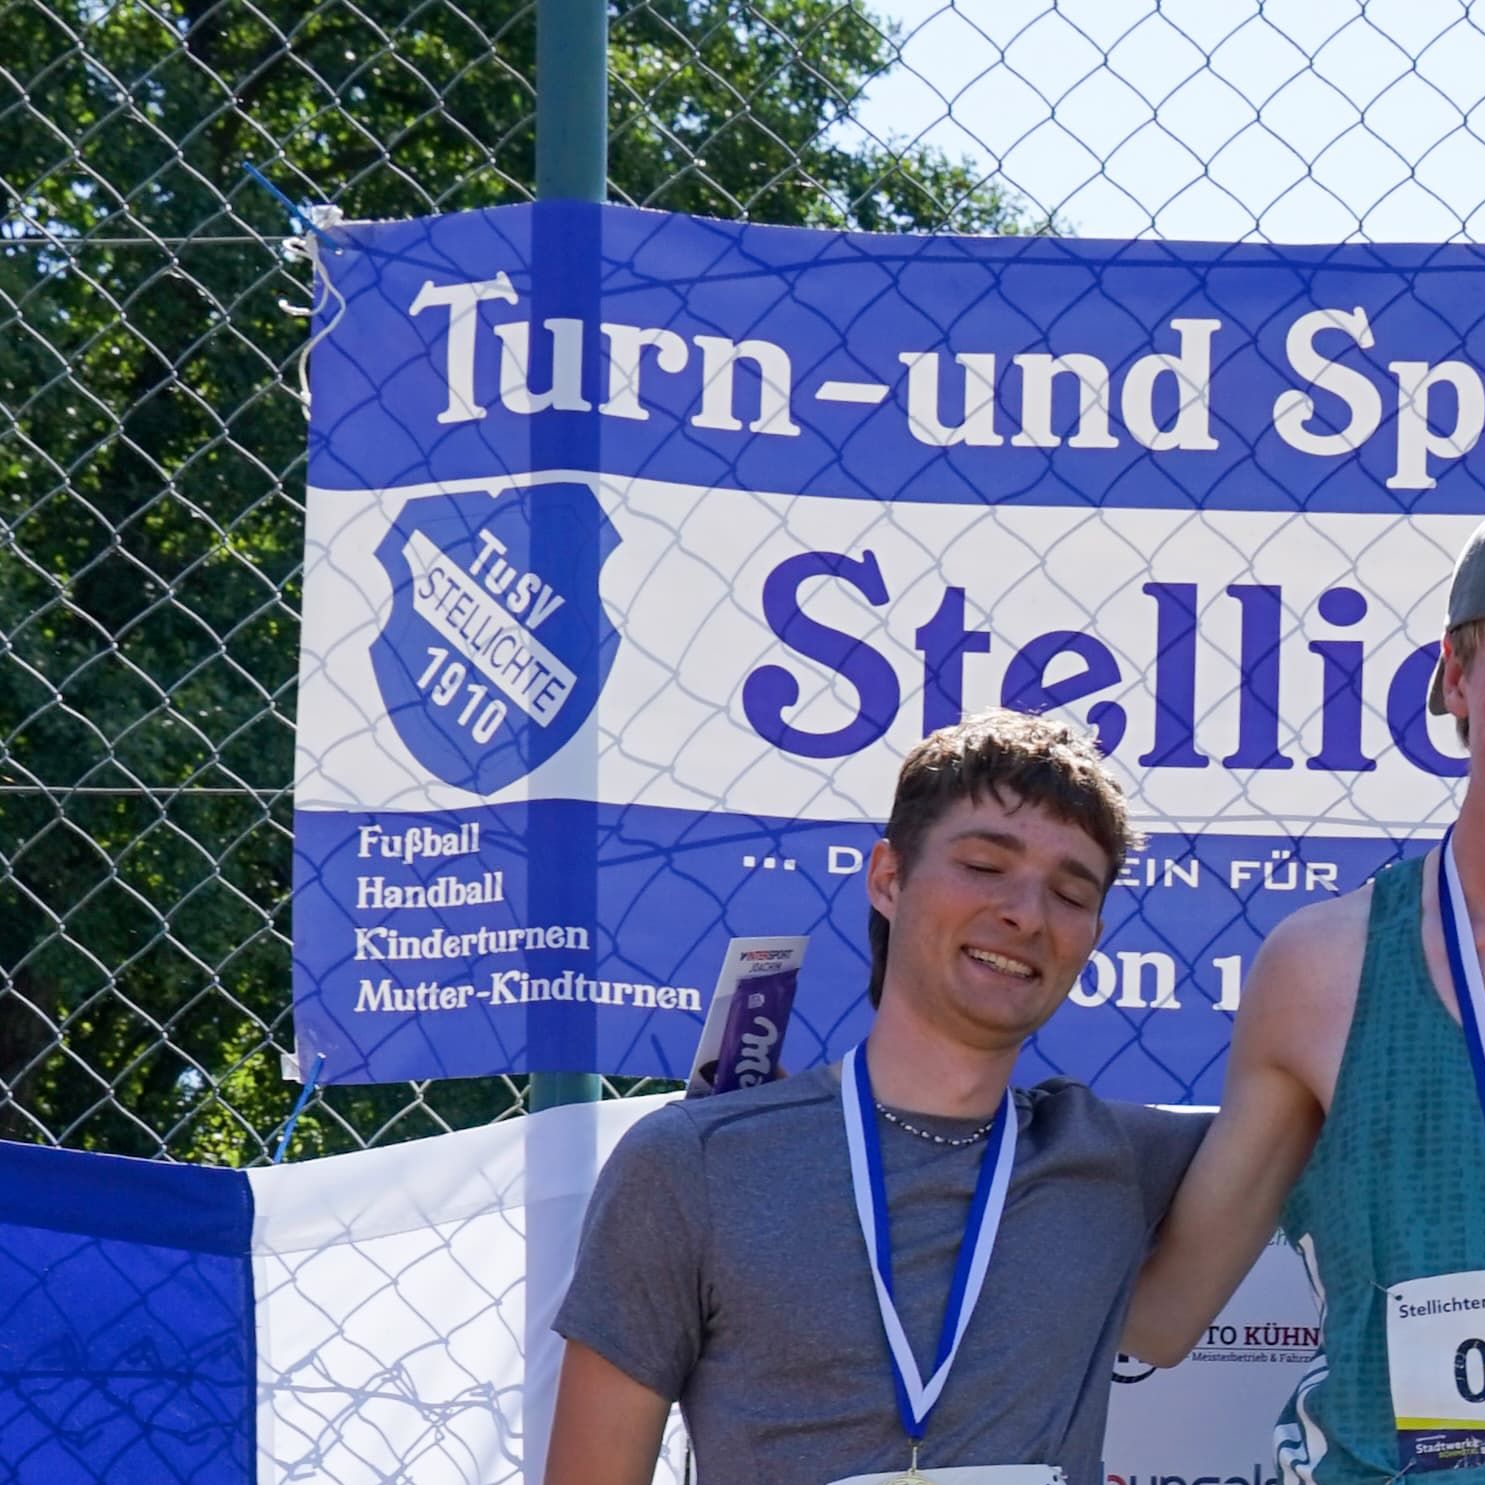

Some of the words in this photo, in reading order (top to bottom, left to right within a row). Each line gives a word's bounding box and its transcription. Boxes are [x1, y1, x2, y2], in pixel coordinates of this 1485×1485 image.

[408, 269, 1220, 452] Turn-und
[468, 528, 566, 631] TuSV
[417, 567, 566, 713] STELLICHTE
[417, 647, 507, 744] 1910
[357, 823, 481, 865] Fußball
[356, 871, 504, 910] Handball
[1230, 850, 1339, 890] FÜR
[353, 924, 591, 961] Kinderturnen
[353, 973, 702, 1013] Mutter-Kindturnen
[1244, 1322, 1319, 1346] KÜHN
